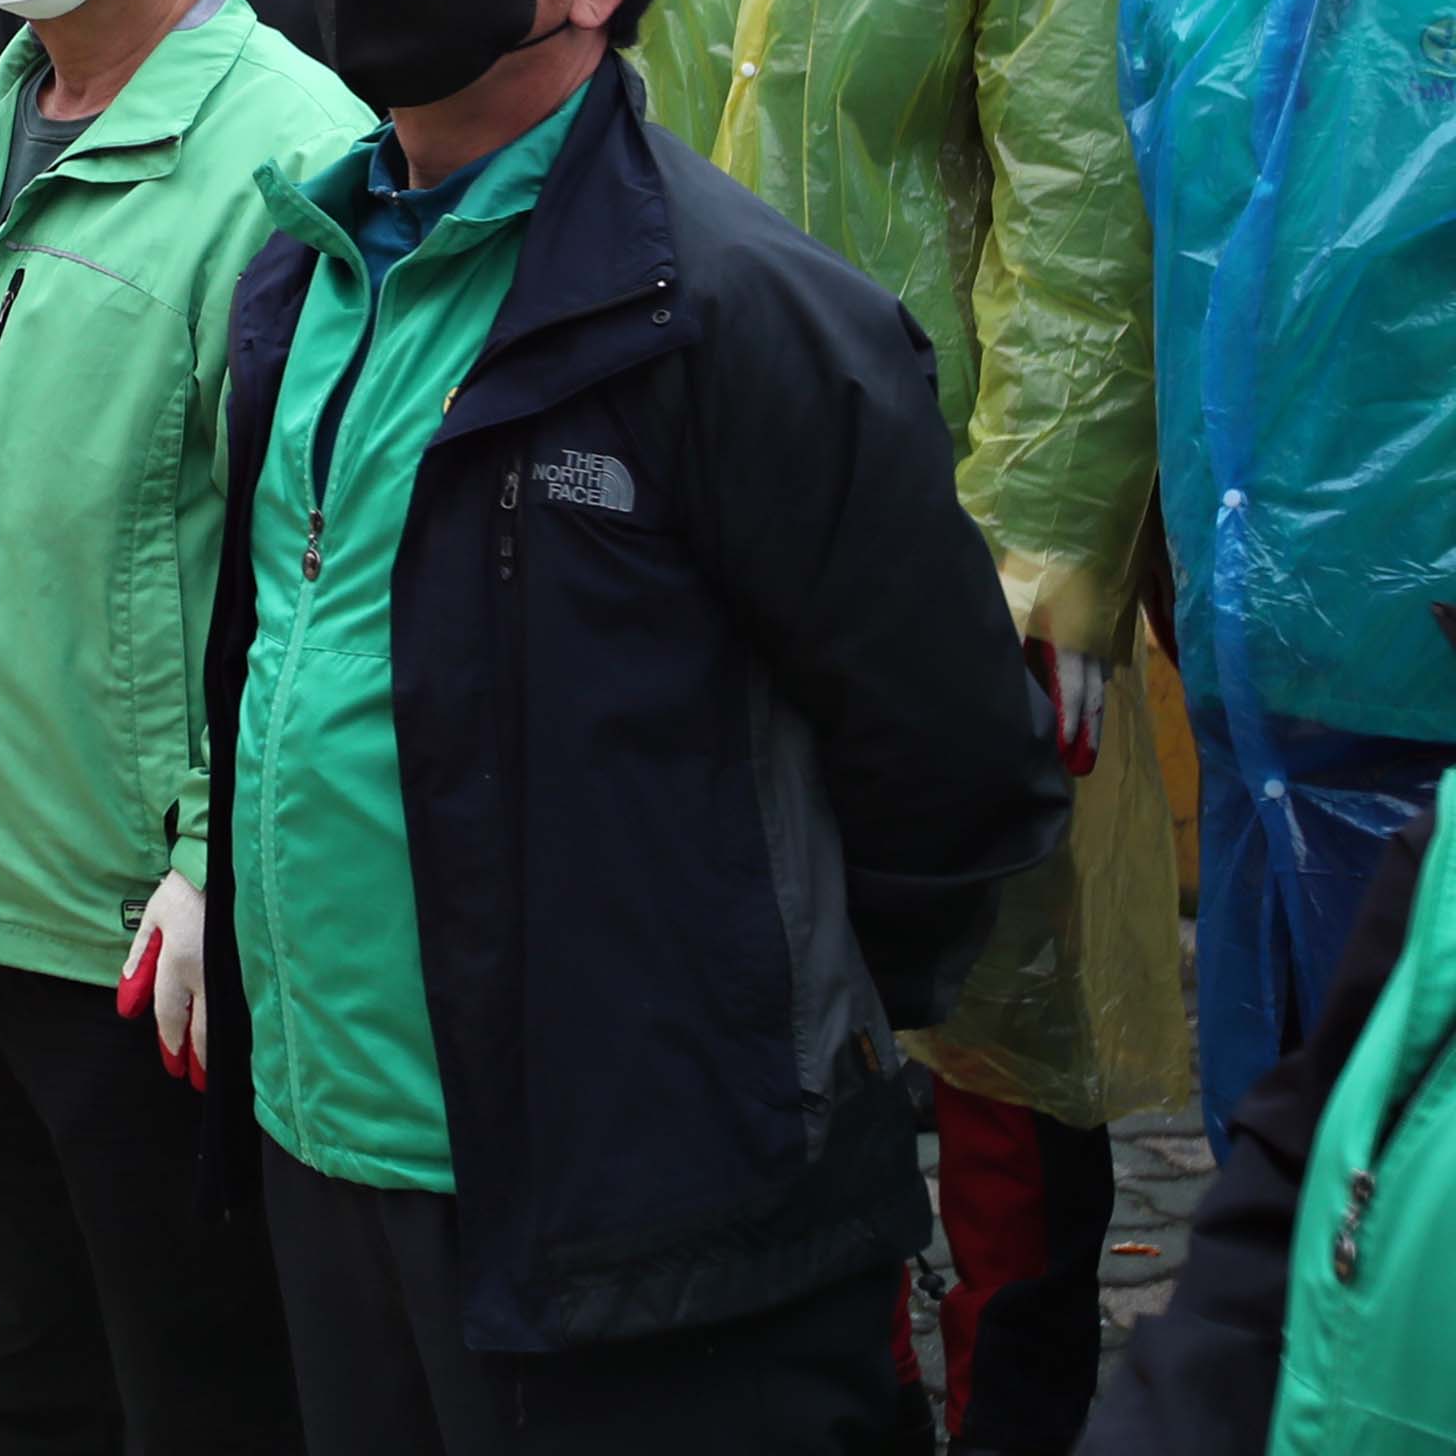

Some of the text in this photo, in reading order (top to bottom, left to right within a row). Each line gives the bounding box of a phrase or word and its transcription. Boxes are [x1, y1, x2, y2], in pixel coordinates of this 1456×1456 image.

[561, 448, 605, 472] THE
[531, 462, 601, 489] NORTH
[547, 482, 602, 507] FACE
